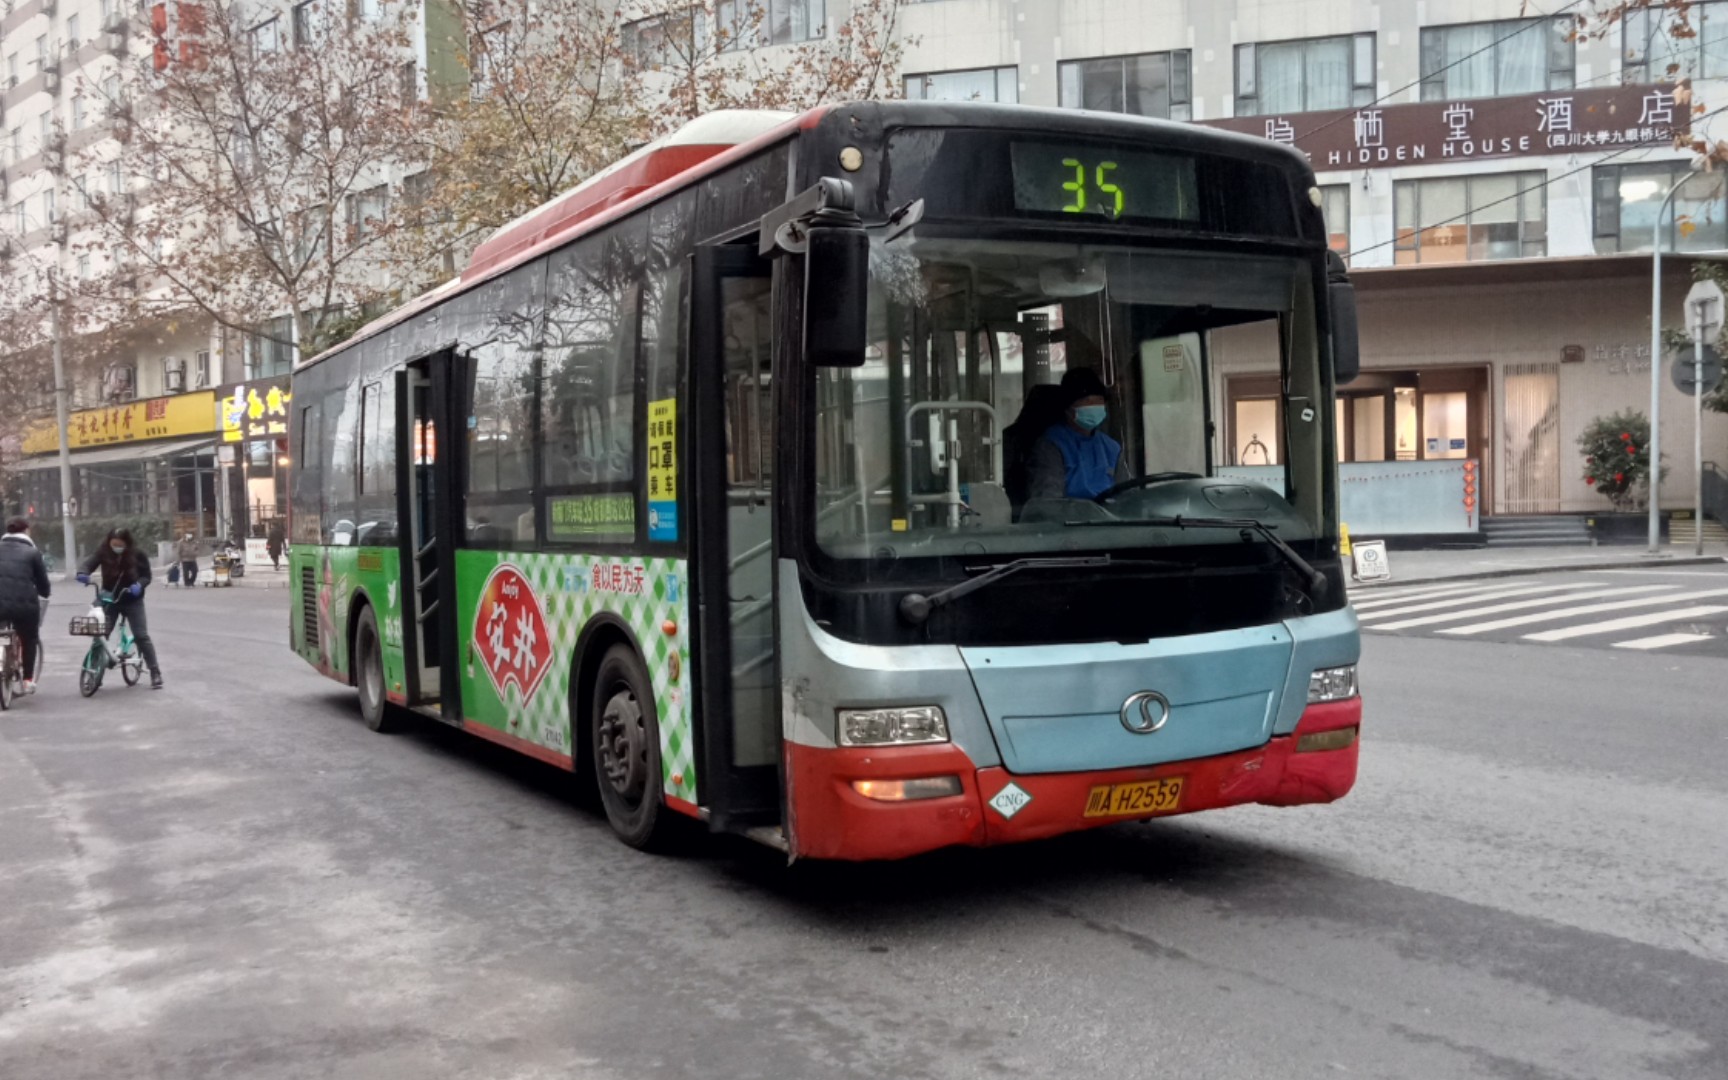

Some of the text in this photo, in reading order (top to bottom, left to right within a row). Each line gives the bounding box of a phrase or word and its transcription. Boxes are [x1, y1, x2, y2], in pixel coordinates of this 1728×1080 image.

[1328, 145, 1425, 165] HIDDEN
[1442, 136, 1530, 156] HOUSE
[1062, 158, 1122, 219] 35
[593, 564, 644, 593] 食以民为天
[486, 601, 536, 681] 安井
[995, 793, 1023, 808] CNG
